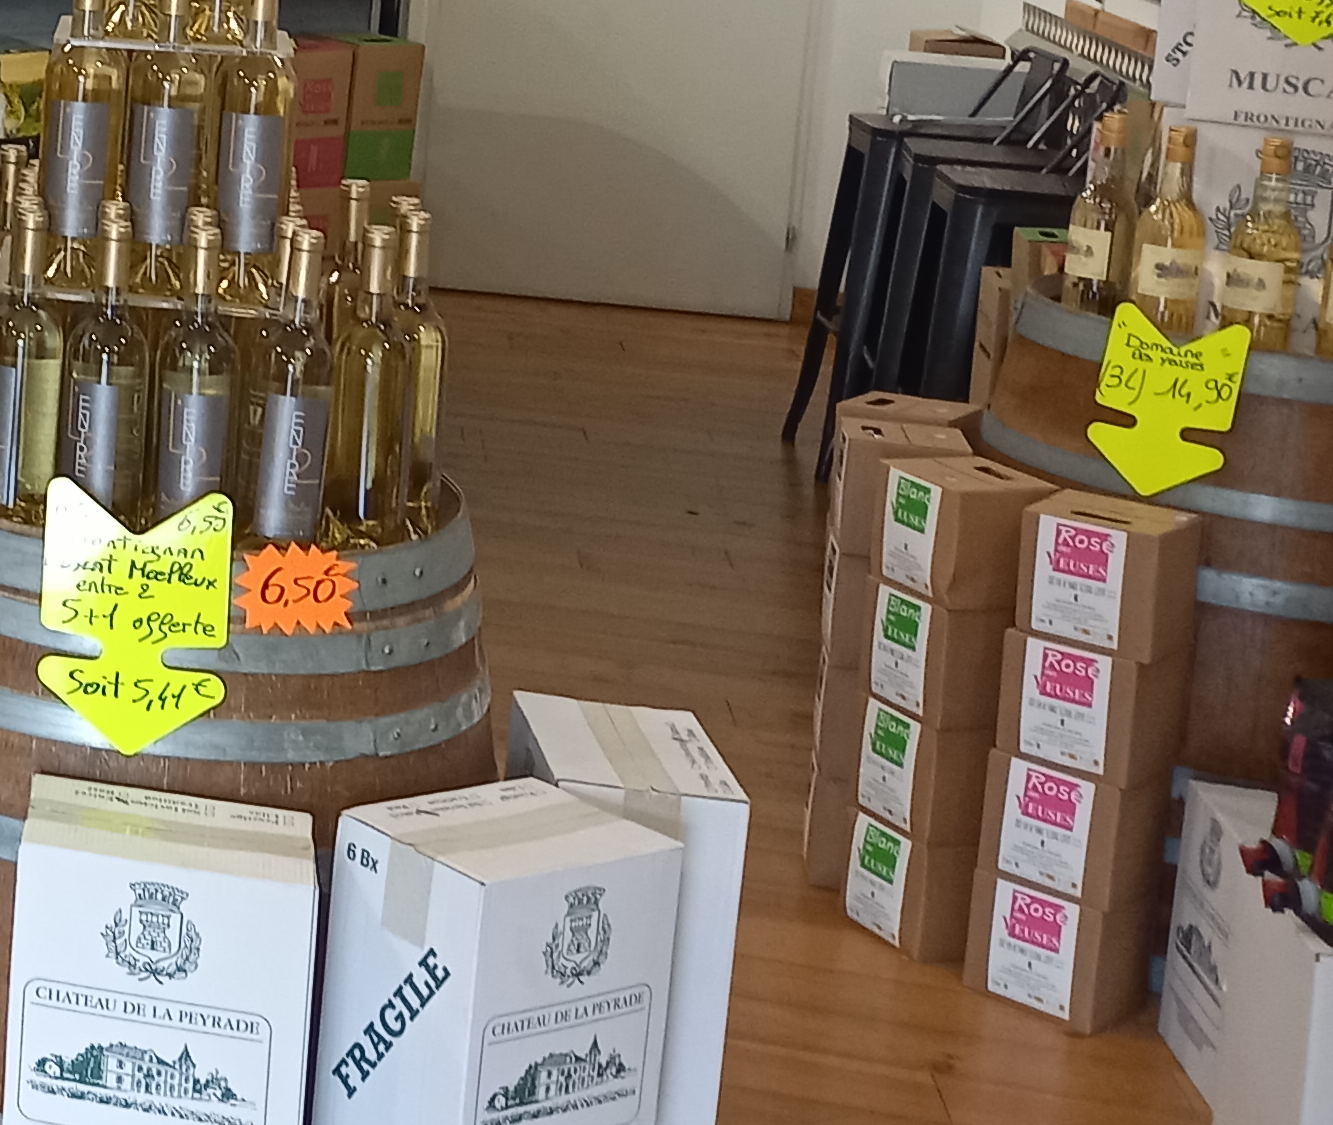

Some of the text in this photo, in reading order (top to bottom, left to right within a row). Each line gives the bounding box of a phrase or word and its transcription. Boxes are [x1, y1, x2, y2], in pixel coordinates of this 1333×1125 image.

[76, 578, 155, 599] entre 2
[66, 669, 125, 699] Soit
[346, 842, 357, 861] 6
[35, 985, 261, 1036] CHATEAU DE LA PEYRADE
[331, 947, 452, 1100] FRAGILE
[491, 990, 645, 1038] CHATEAU DE LA PEYRADE
